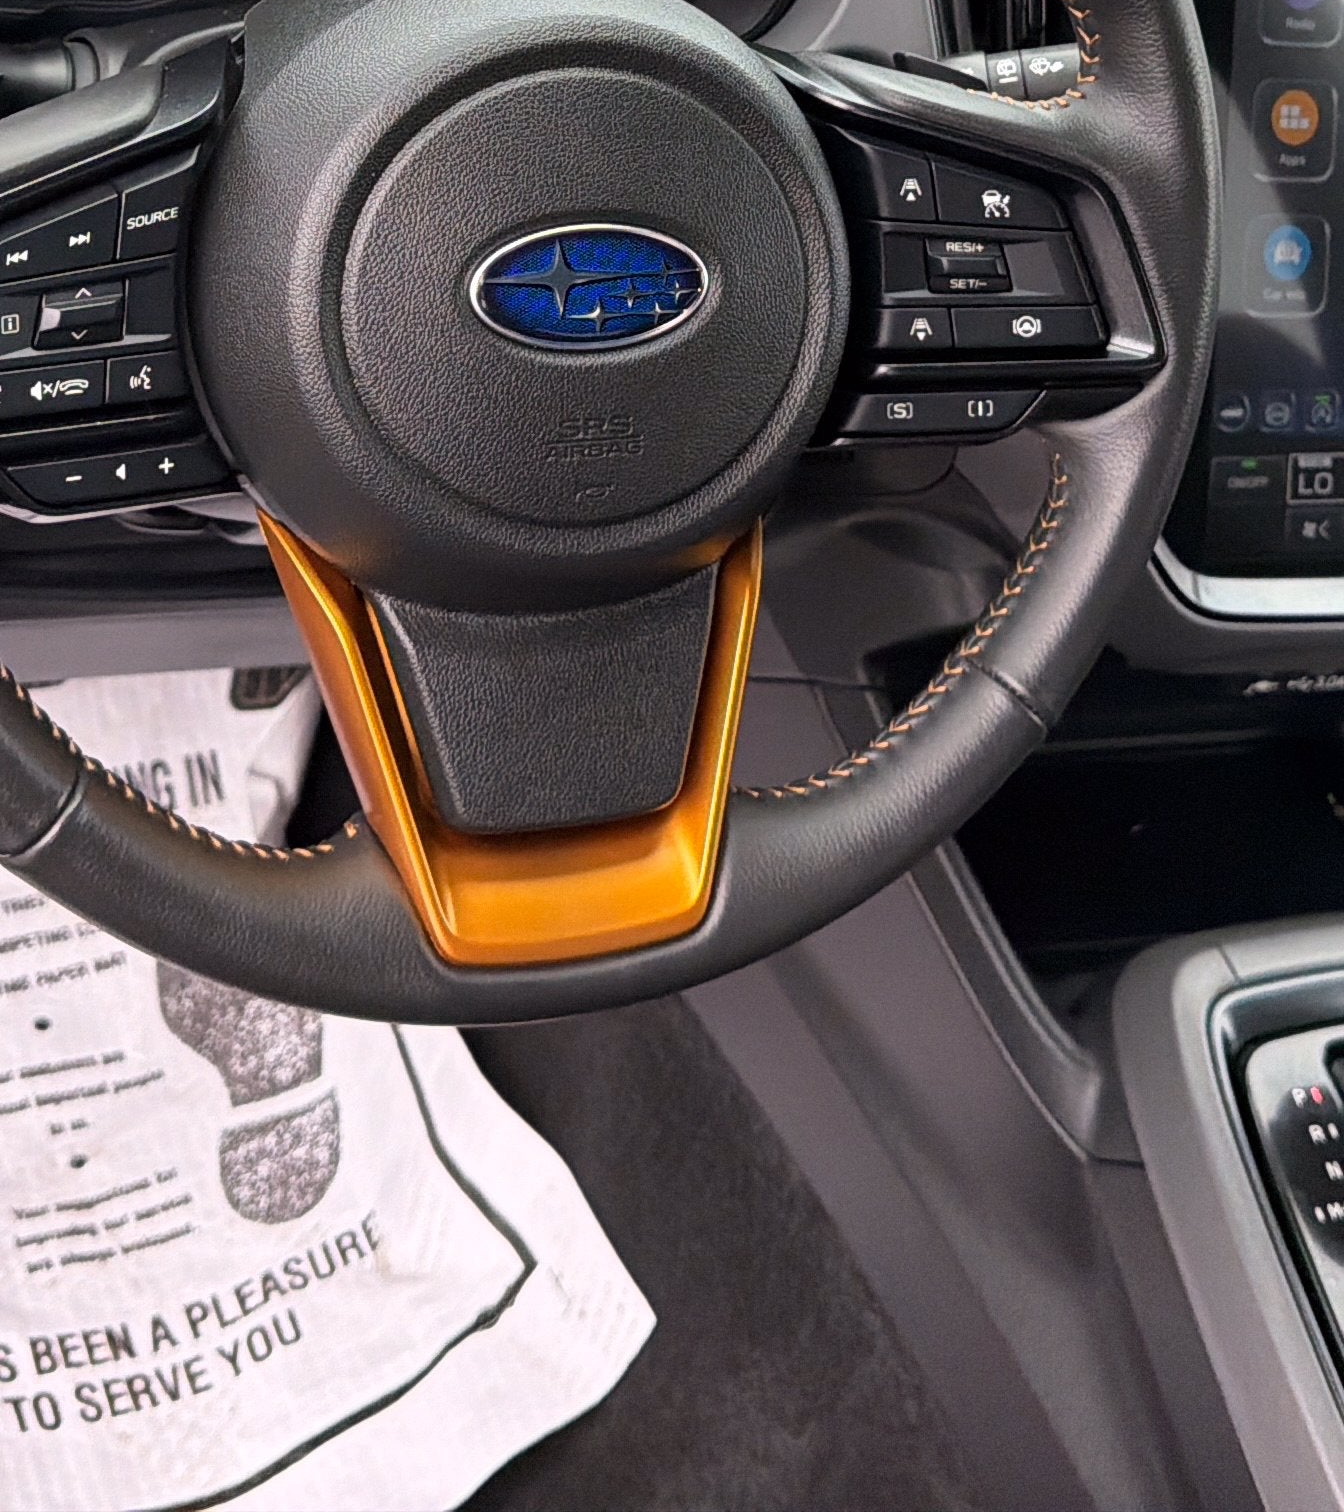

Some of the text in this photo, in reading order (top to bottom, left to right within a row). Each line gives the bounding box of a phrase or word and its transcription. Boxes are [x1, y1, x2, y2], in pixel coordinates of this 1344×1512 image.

[126, 206, 180, 232] SOURCE
[1298, 471, 1334, 495] LO
[184, 749, 226, 808] IN
[1291, 1087, 1307, 1108] P
[1308, 1123, 1328, 1144] R
[1324, 1159, 1344, 1181] N
[28, 1320, 137, 1377] BEEN
[150, 1314, 180, 1352] A
[184, 1208, 381, 1339] PLEASURE
[4, 1307, 303, 1434] TO SERVE YOU
